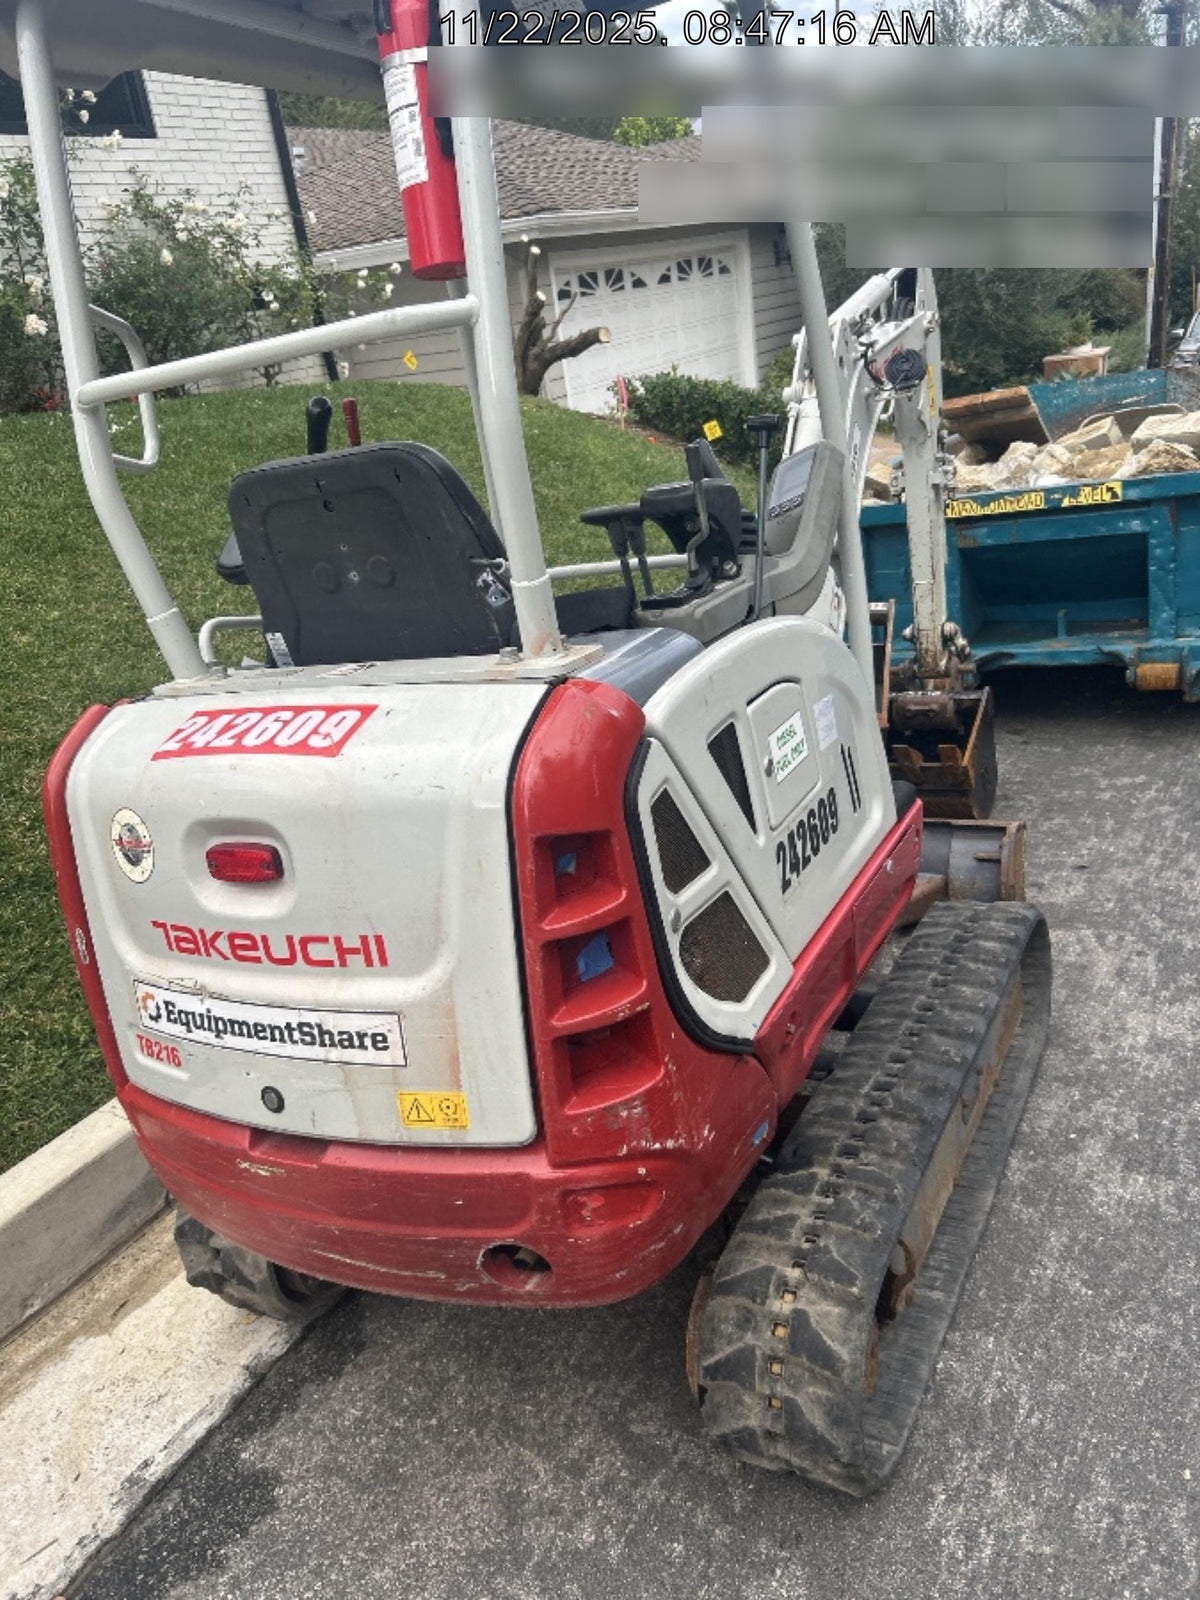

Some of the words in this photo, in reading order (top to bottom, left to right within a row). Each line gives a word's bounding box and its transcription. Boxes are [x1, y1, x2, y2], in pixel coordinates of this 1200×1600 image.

[158, 709, 362, 752] 242609
[776, 787, 839, 895] 242609
[163, 1000, 390, 1051] EquipmentShare
[136, 1034, 182, 1068] TB216
